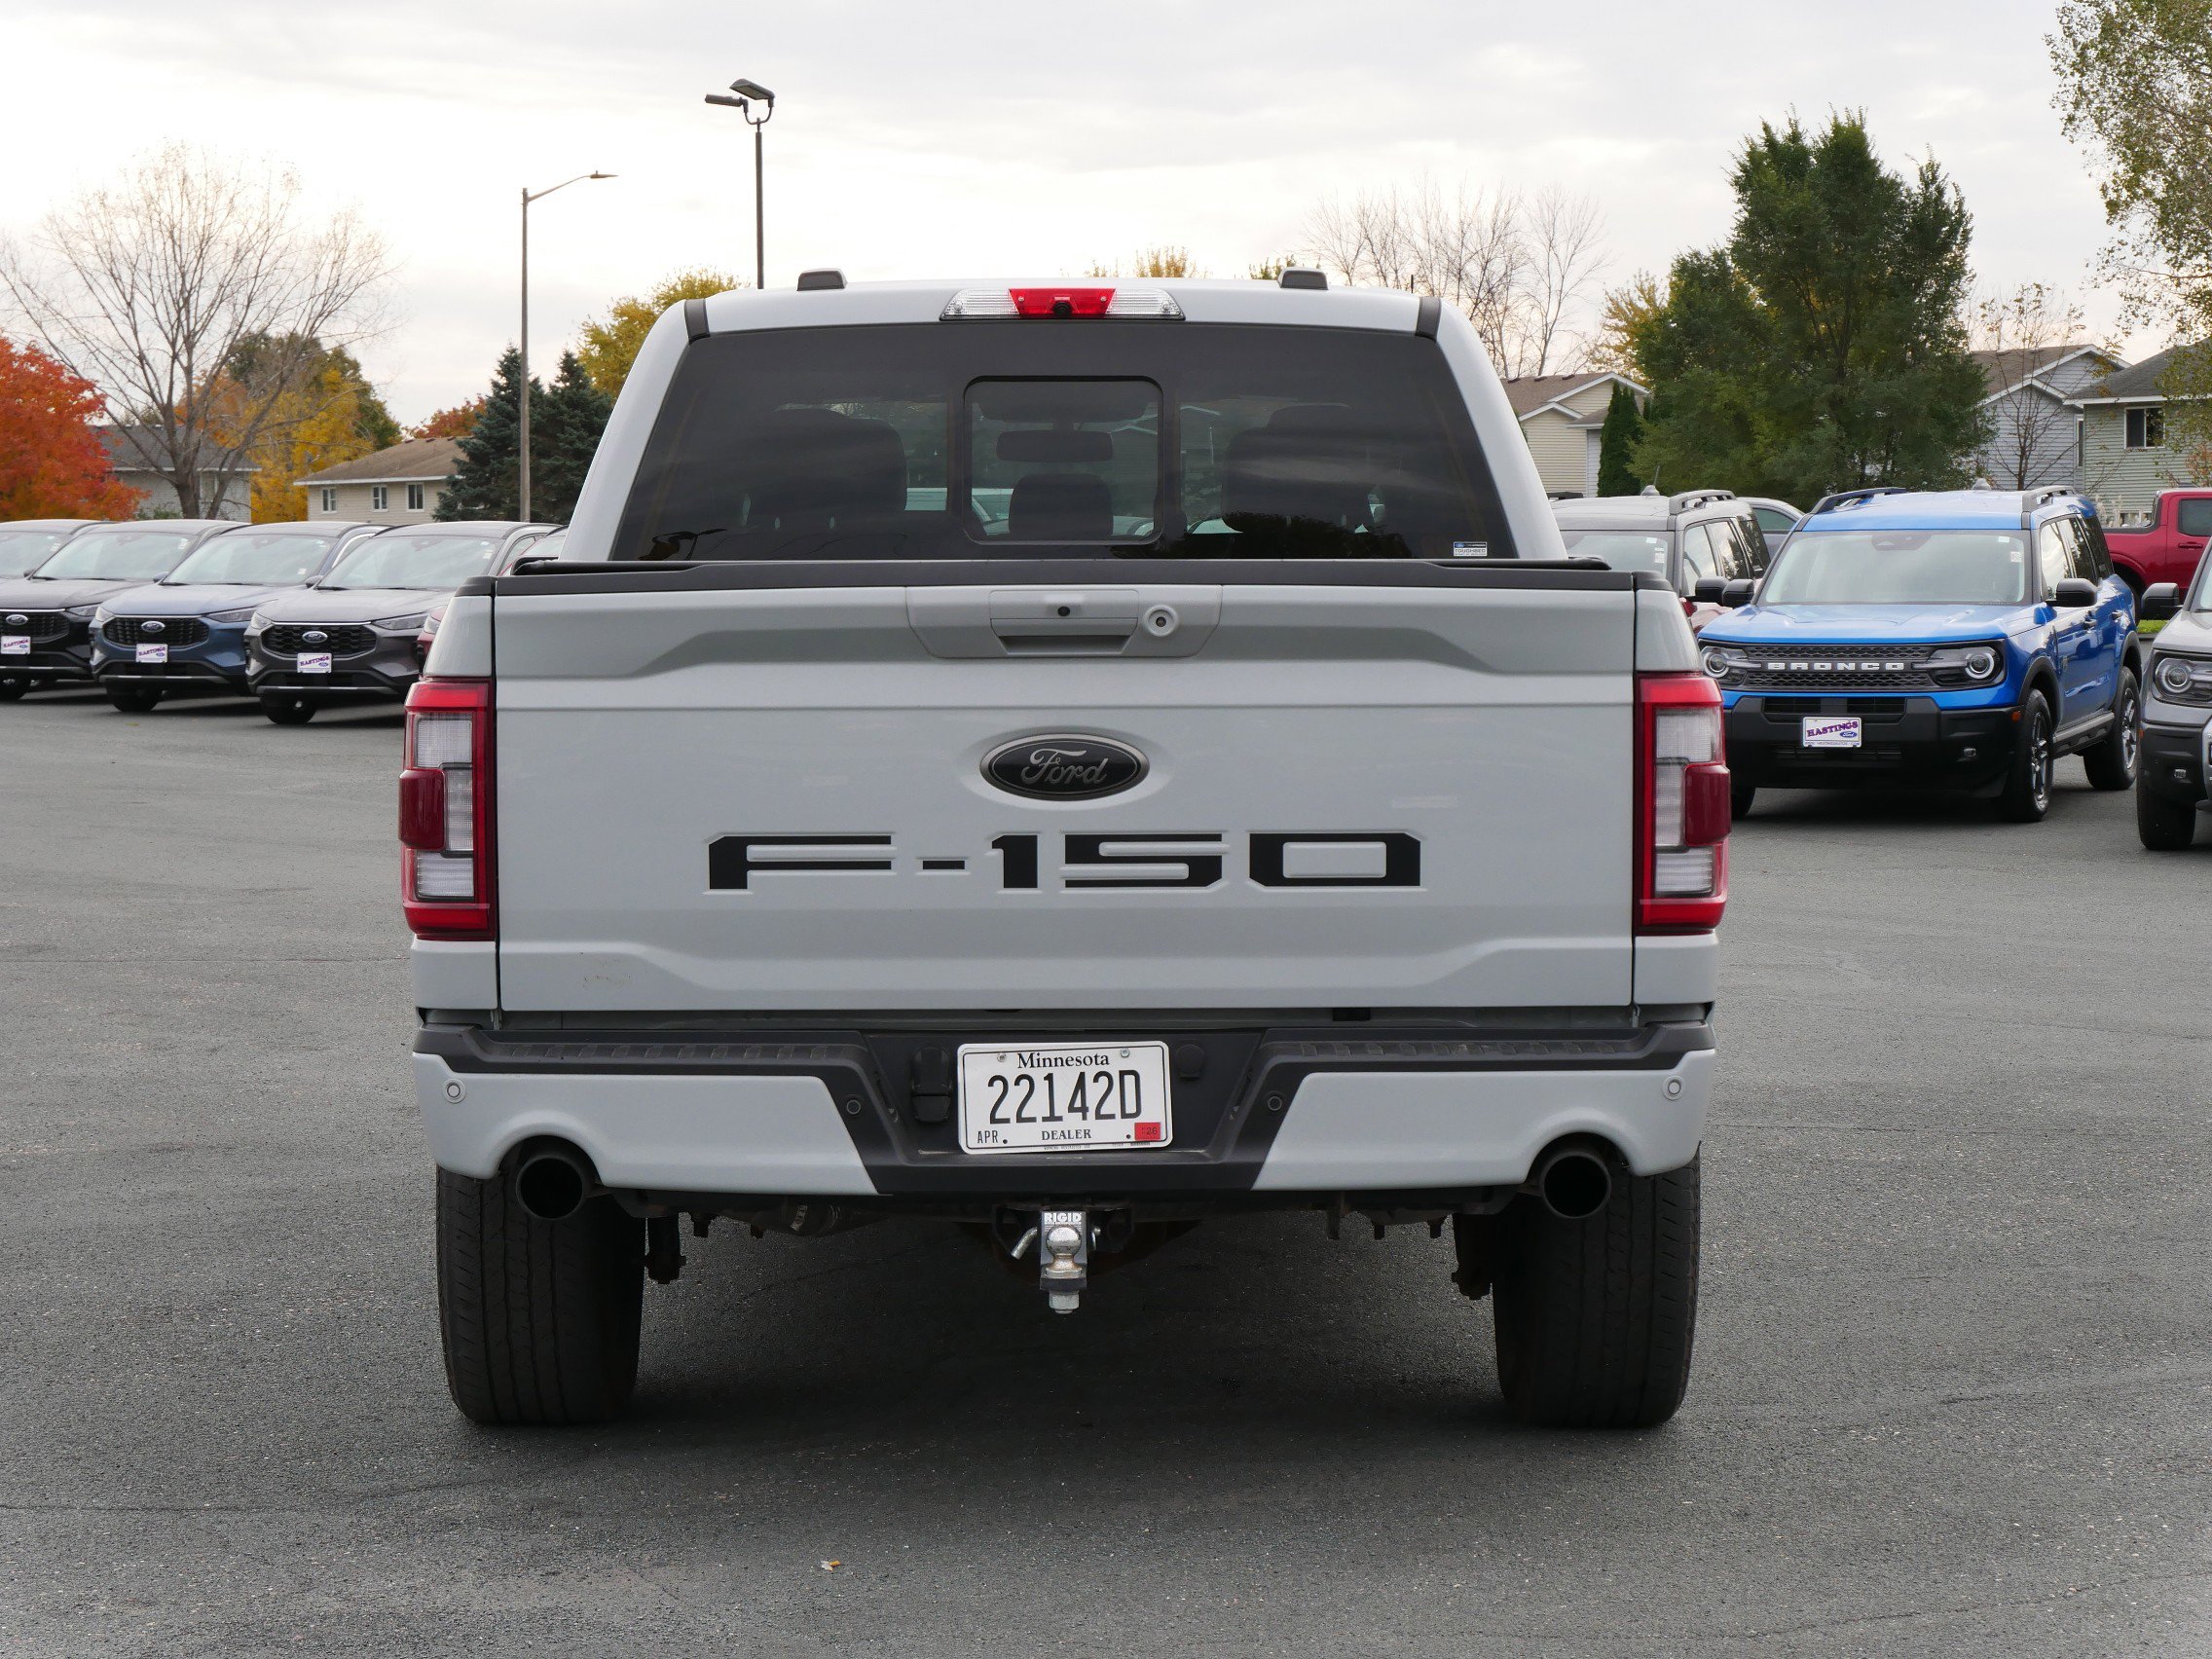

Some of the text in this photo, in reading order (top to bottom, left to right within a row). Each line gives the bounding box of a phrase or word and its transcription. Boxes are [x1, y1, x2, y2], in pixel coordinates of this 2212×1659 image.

[1767, 662, 1905, 671] BRONCO
[1806, 720, 1859, 738] HASTINGS
[1020, 748, 1109, 785] Ford
[708, 831, 1421, 890] F-150
[1017, 1052, 1110, 1069] Minnesota
[987, 1069, 1142, 1124] 22142D
[977, 1130, 999, 1144] APR
[1041, 1128, 1092, 1141] DEALER
[1044, 1212, 1082, 1224] RIGID
